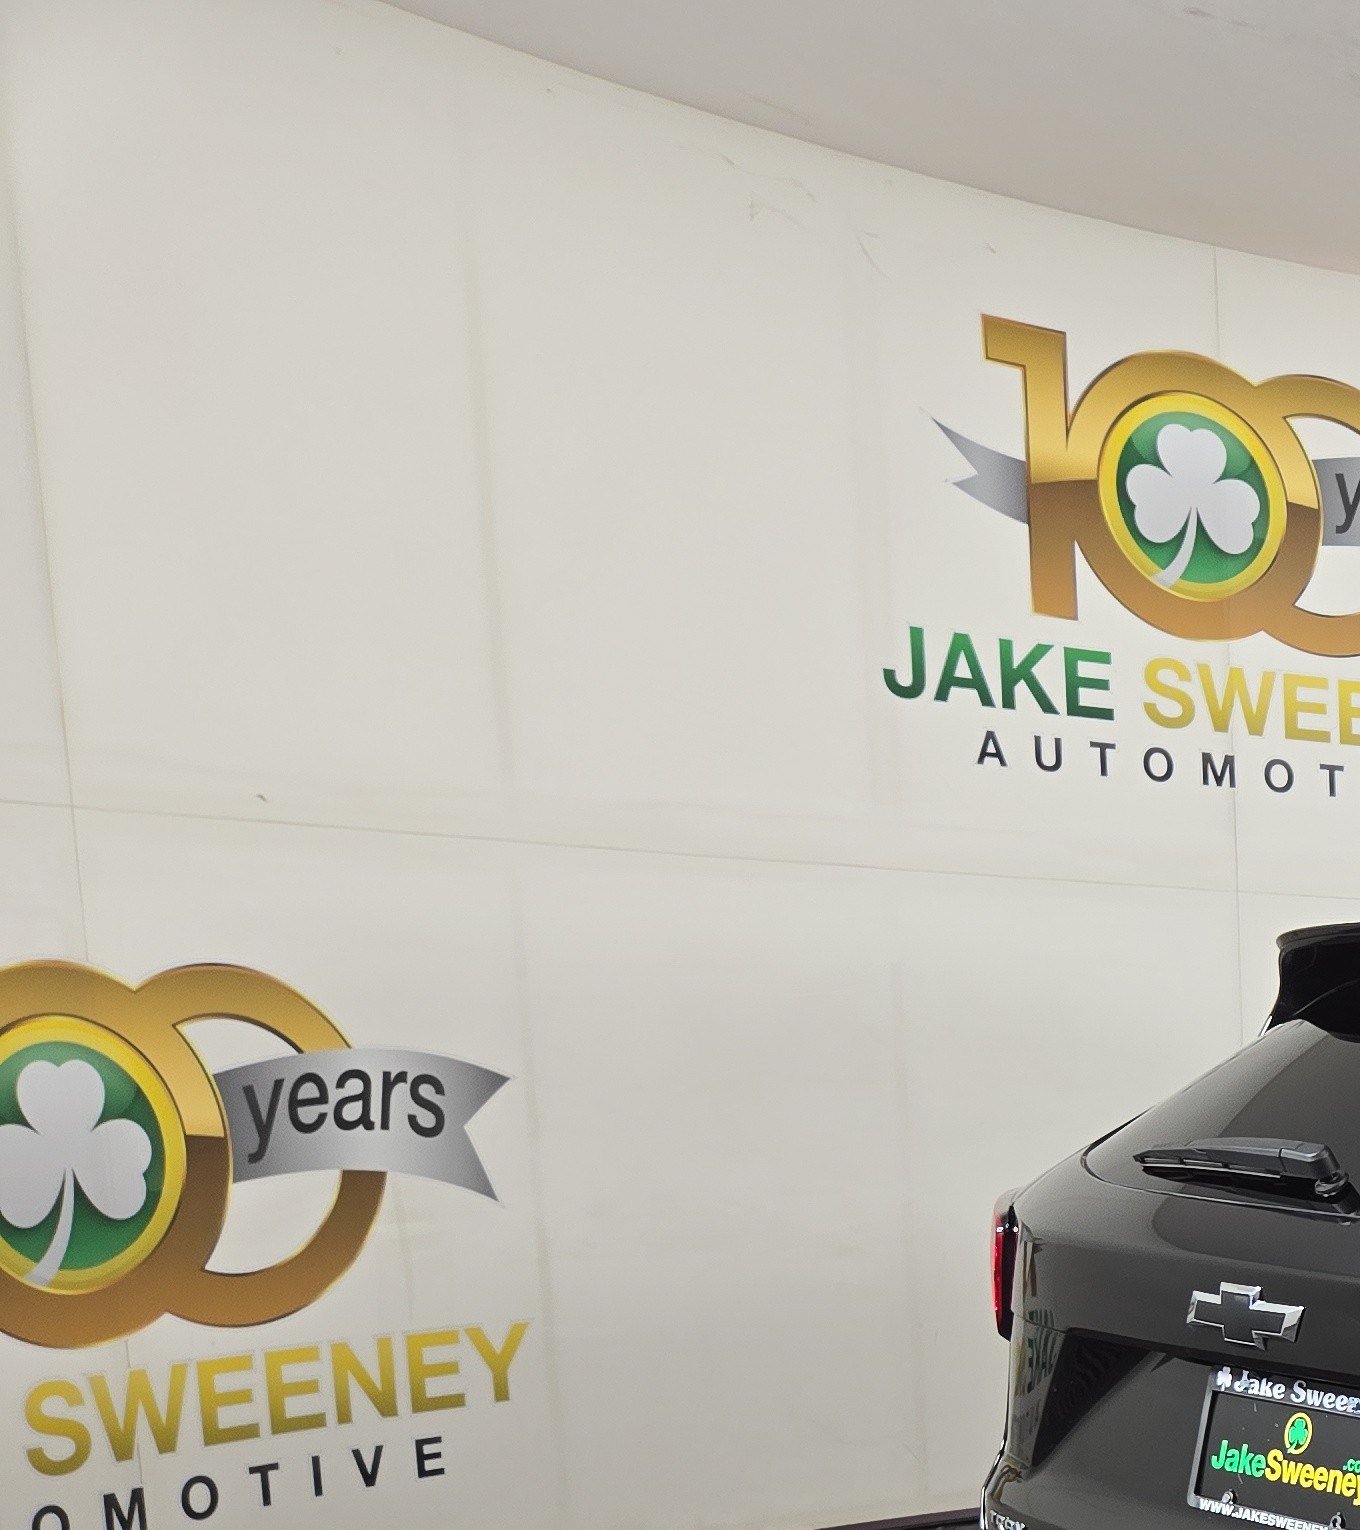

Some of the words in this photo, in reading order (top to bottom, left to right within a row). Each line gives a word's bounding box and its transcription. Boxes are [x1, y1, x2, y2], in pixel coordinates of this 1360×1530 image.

[883, 625, 1114, 721] JAKE
[242, 1067, 446, 1164] years
[24, 1321, 528, 1476] SWEENEY
[1234, 1370, 1286, 1400] Jake
